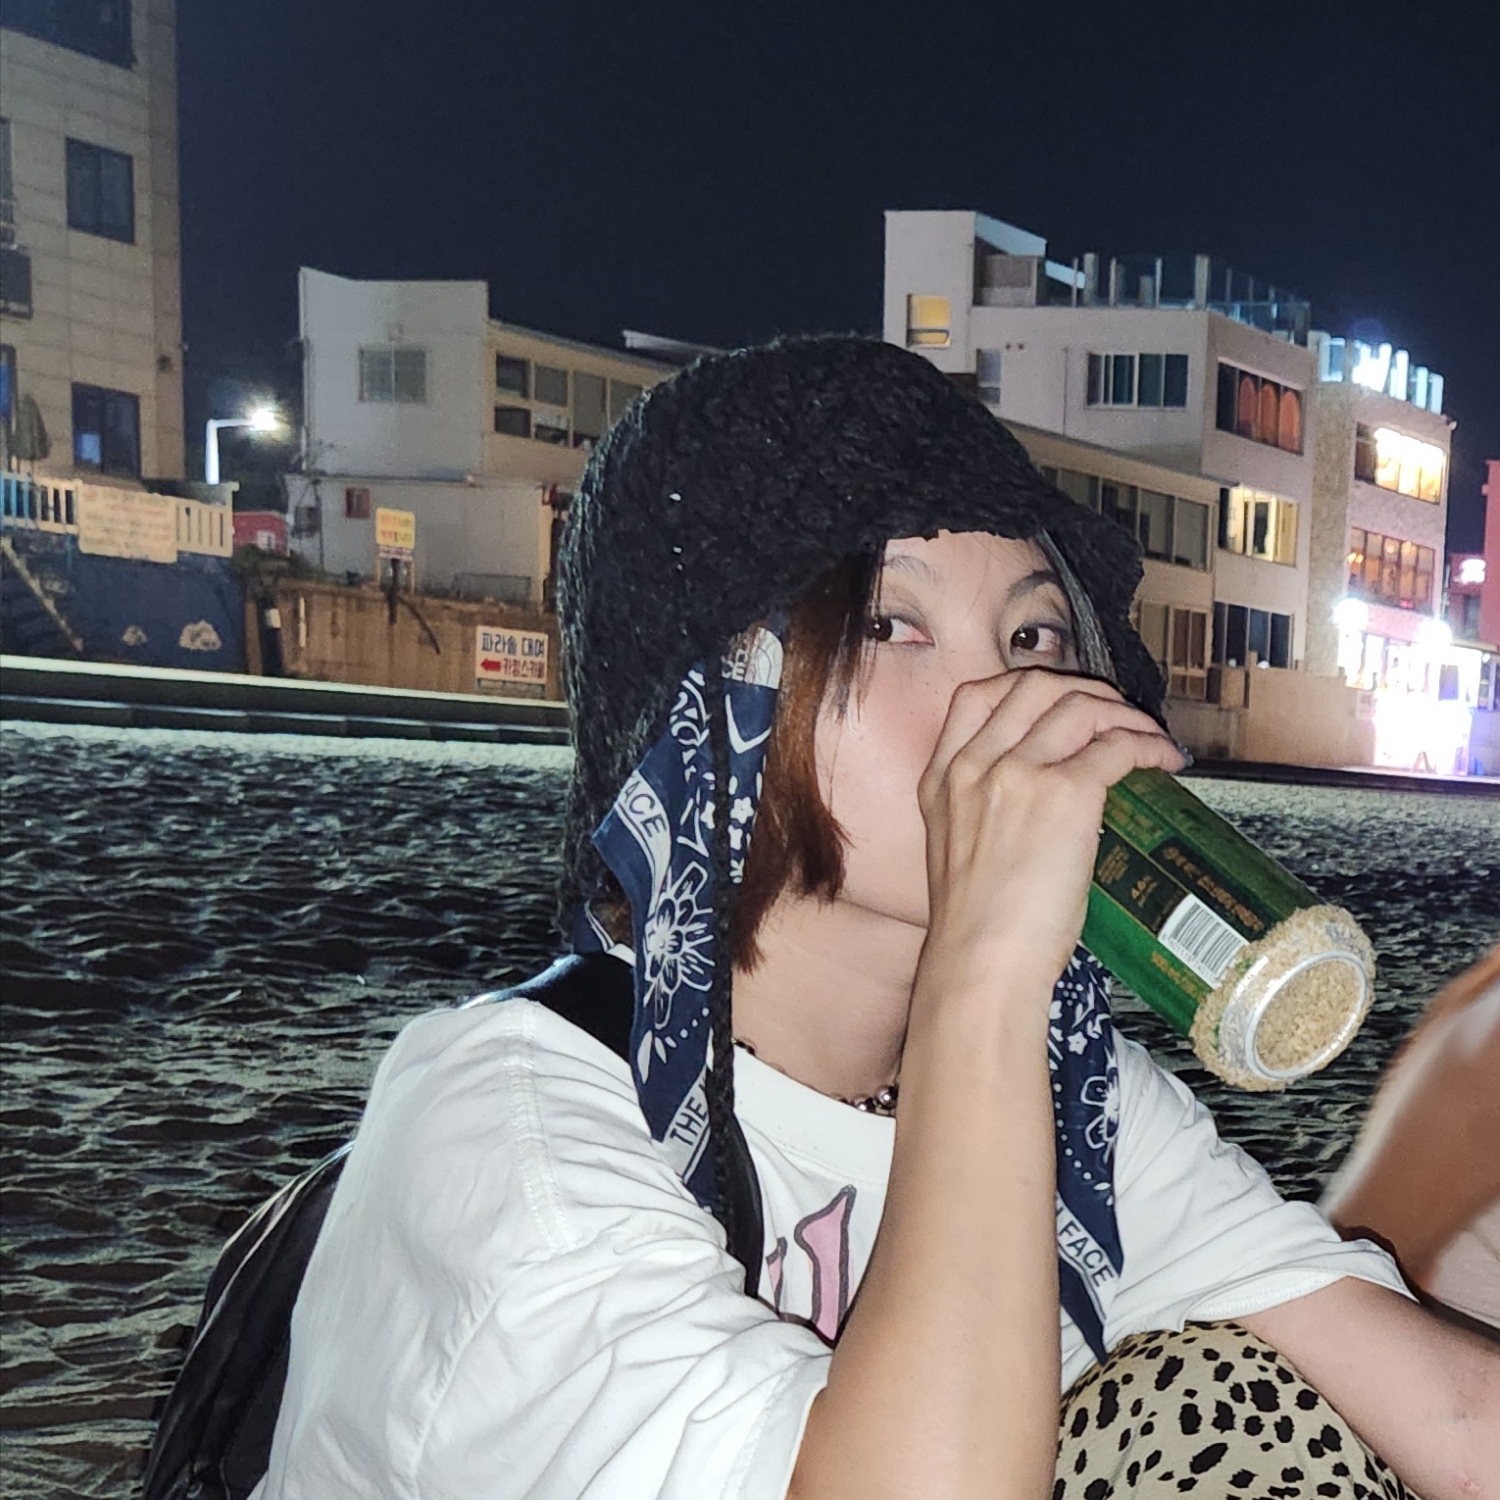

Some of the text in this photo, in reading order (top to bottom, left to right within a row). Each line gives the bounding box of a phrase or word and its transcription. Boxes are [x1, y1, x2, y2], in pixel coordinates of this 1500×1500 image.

[481, 632, 545, 658] 파라솔 대여
[624, 780, 667, 838] ACE
[670, 1096, 707, 1146] THE
[1060, 1220, 1114, 1287] FACE
